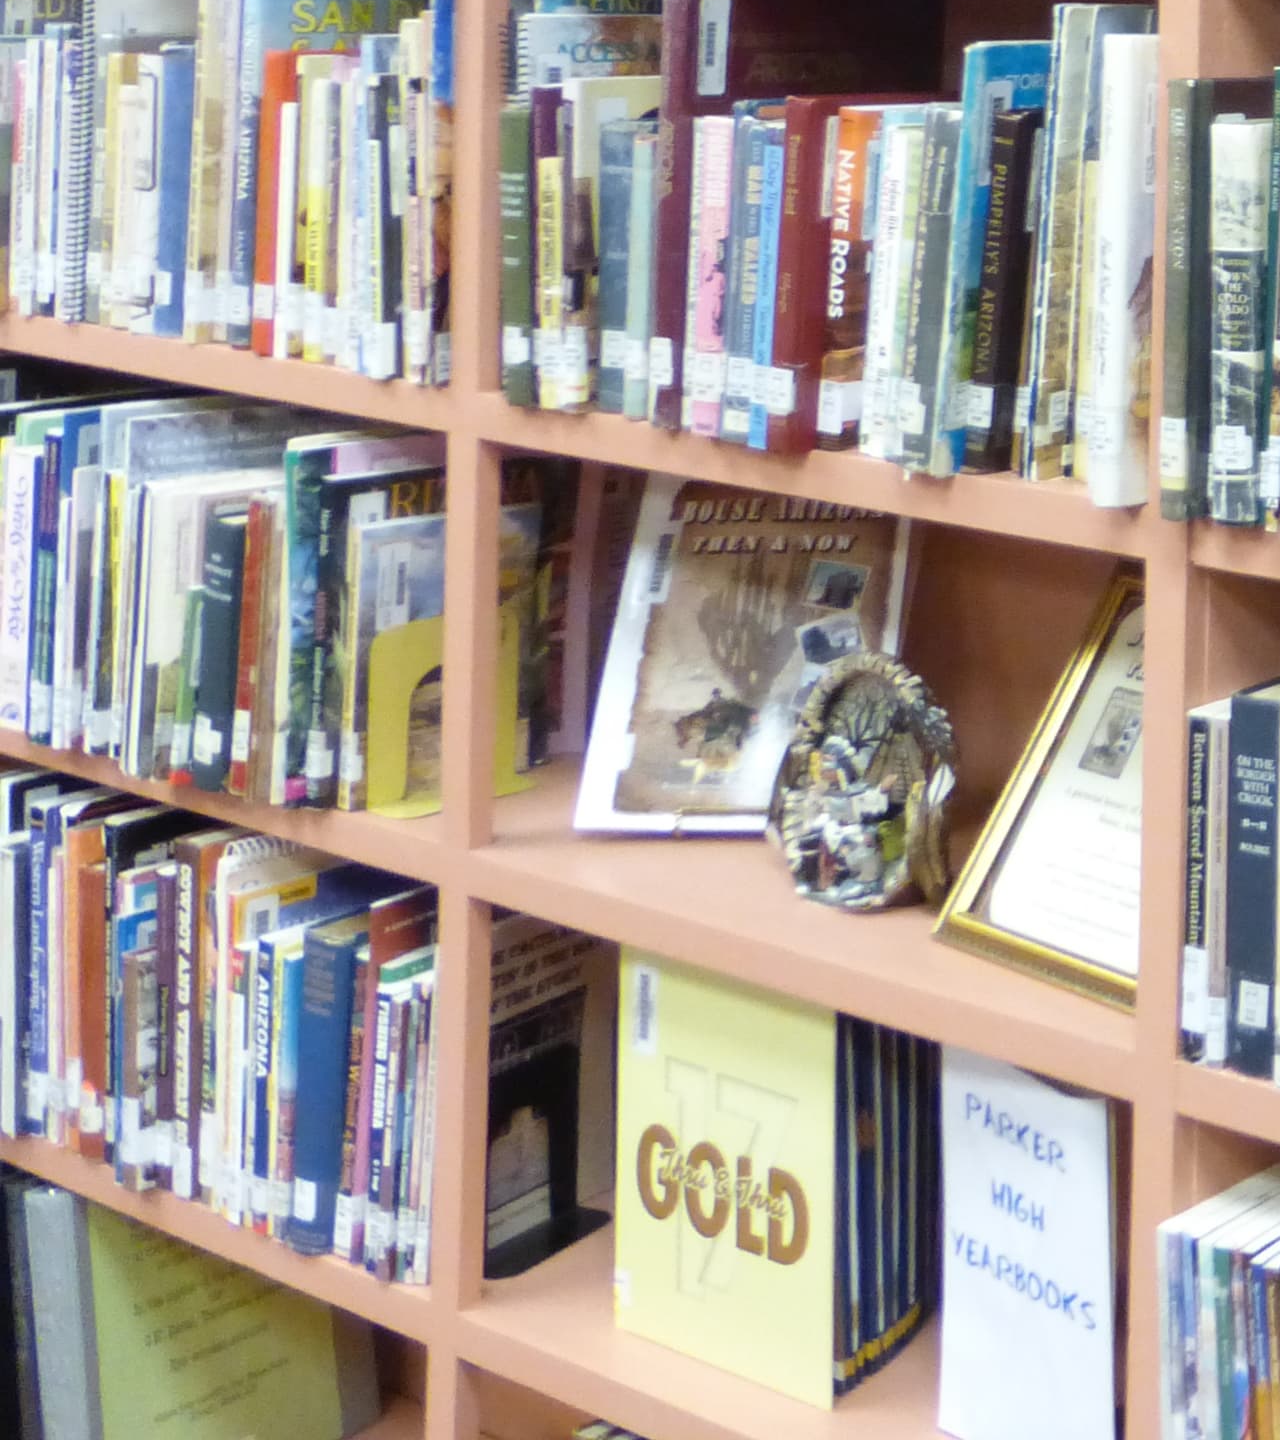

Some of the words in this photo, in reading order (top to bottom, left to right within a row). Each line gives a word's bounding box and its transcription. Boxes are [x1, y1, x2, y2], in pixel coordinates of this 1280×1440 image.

[292, 0, 377, 34] SAN
[237, 125, 254, 200] ARIZONA
[833, 148, 857, 232] NATIVE
[985, 162, 1008, 275] PUMPELLY'S
[827, 238, 851, 318] ROADS
[974, 287, 998, 374] ARIZONA
[683, 497, 764, 525] BOUSE
[800, 534, 858, 553] NOW
[1191, 731, 1206, 800] Between
[1243, 780, 1270, 794] WITH
[1189, 803, 1206, 857] Sacred
[178, 863, 193, 955] COWBOY
[177, 955, 191, 1005] AND
[175, 1008, 191, 1119] WESTERN
[255, 973, 270, 1078] ARIZONA
[964, 1092, 1068, 1175] PARKER
[635, 1123, 811, 1267] GOLD
[657, 1146, 710, 1193] Thru
[713, 1165, 734, 1200] &
[733, 1173, 793, 1222] Thru
[990, 1179, 1047, 1234] HIGH
[951, 1228, 1099, 1333] YEARBOOKS
